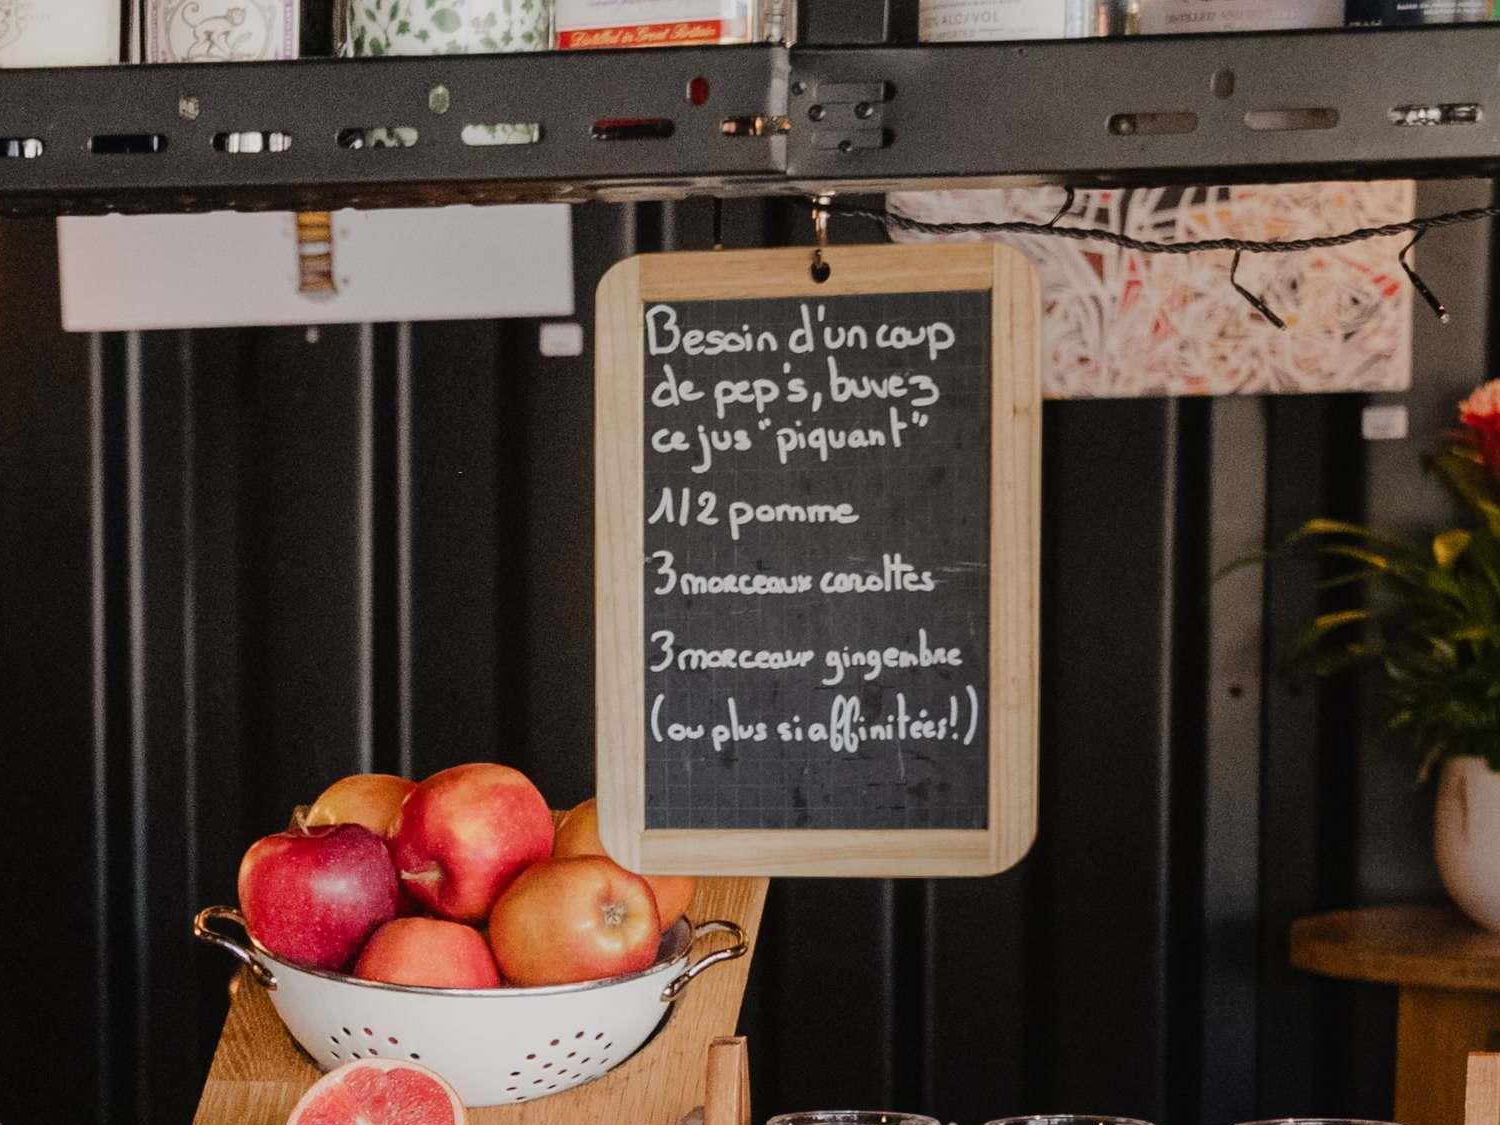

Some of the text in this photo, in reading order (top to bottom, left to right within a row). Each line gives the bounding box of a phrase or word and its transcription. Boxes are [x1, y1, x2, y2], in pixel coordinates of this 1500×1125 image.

[645, 303, 956, 361] Besoin d'un coup
[651, 363, 706, 407] de
[826, 355, 941, 407] buvez
[651, 428, 691, 453] ce
[691, 424, 753, 474] jus
[728, 501, 860, 540] pomme
[651, 550, 936, 596] 3 morceaux carottes
[650, 630, 676, 673] 3
[822, 627, 964, 686] gingembre
[711, 697, 768, 751] plus
[776, 715, 804, 741] si
